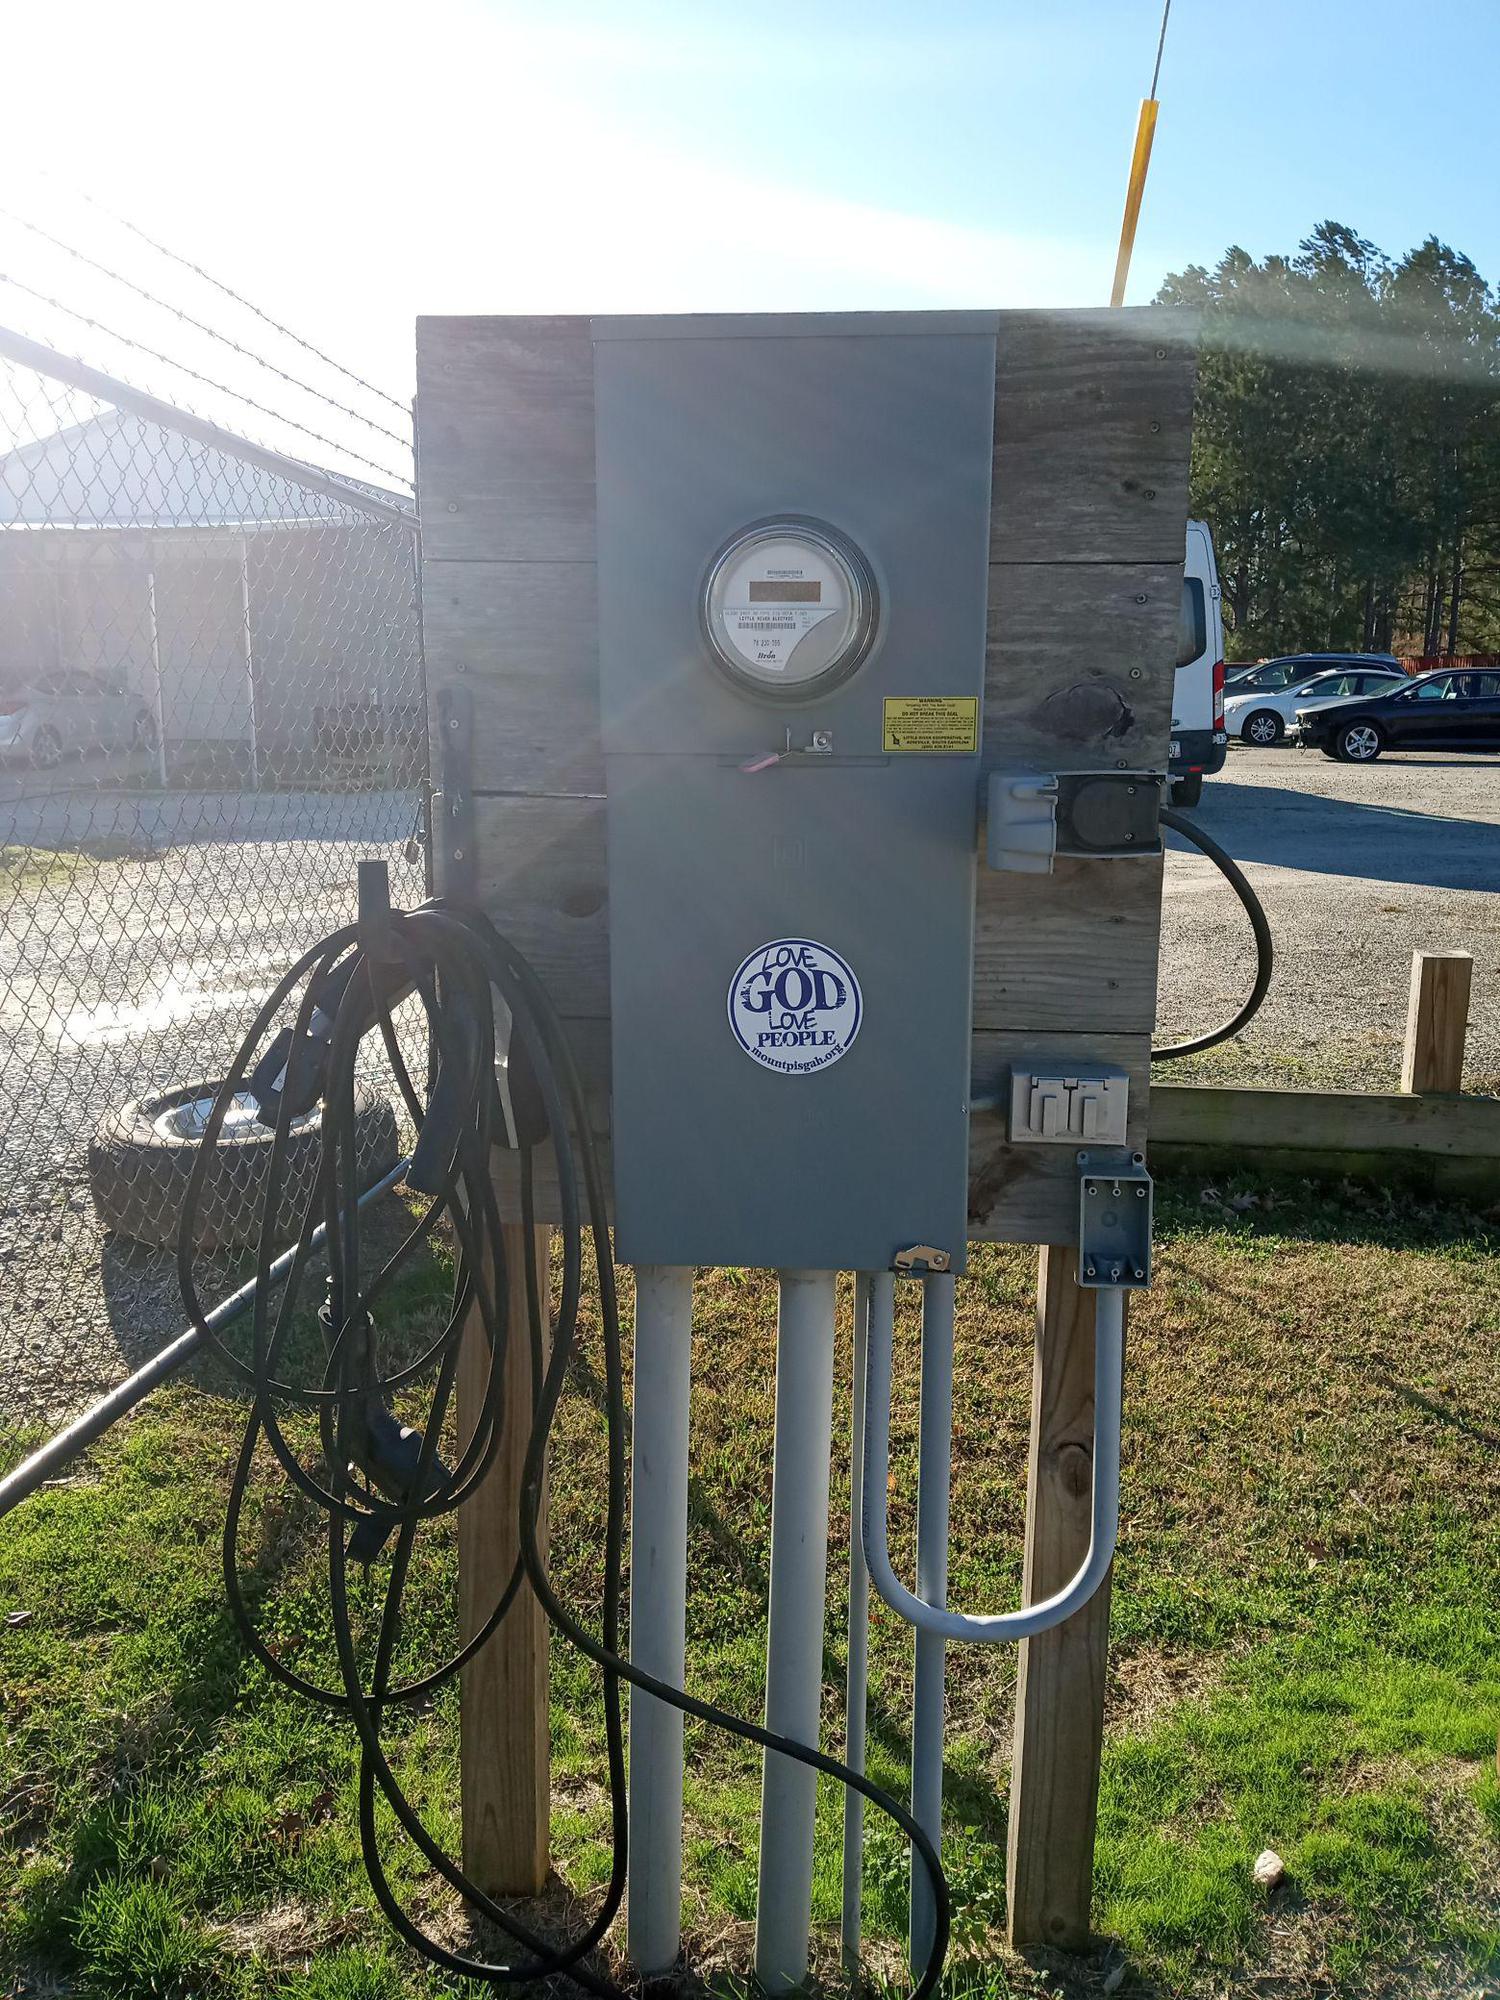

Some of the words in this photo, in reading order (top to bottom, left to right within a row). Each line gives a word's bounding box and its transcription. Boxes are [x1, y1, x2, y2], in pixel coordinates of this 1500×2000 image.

[762, 947, 818, 972] LOVE
[740, 967, 847, 1013] GOD
[768, 1009, 818, 1030] LOVE
[757, 1030, 837, 1048] PEOPLE
[751, 1043, 844, 1072] mountpisgah.org
